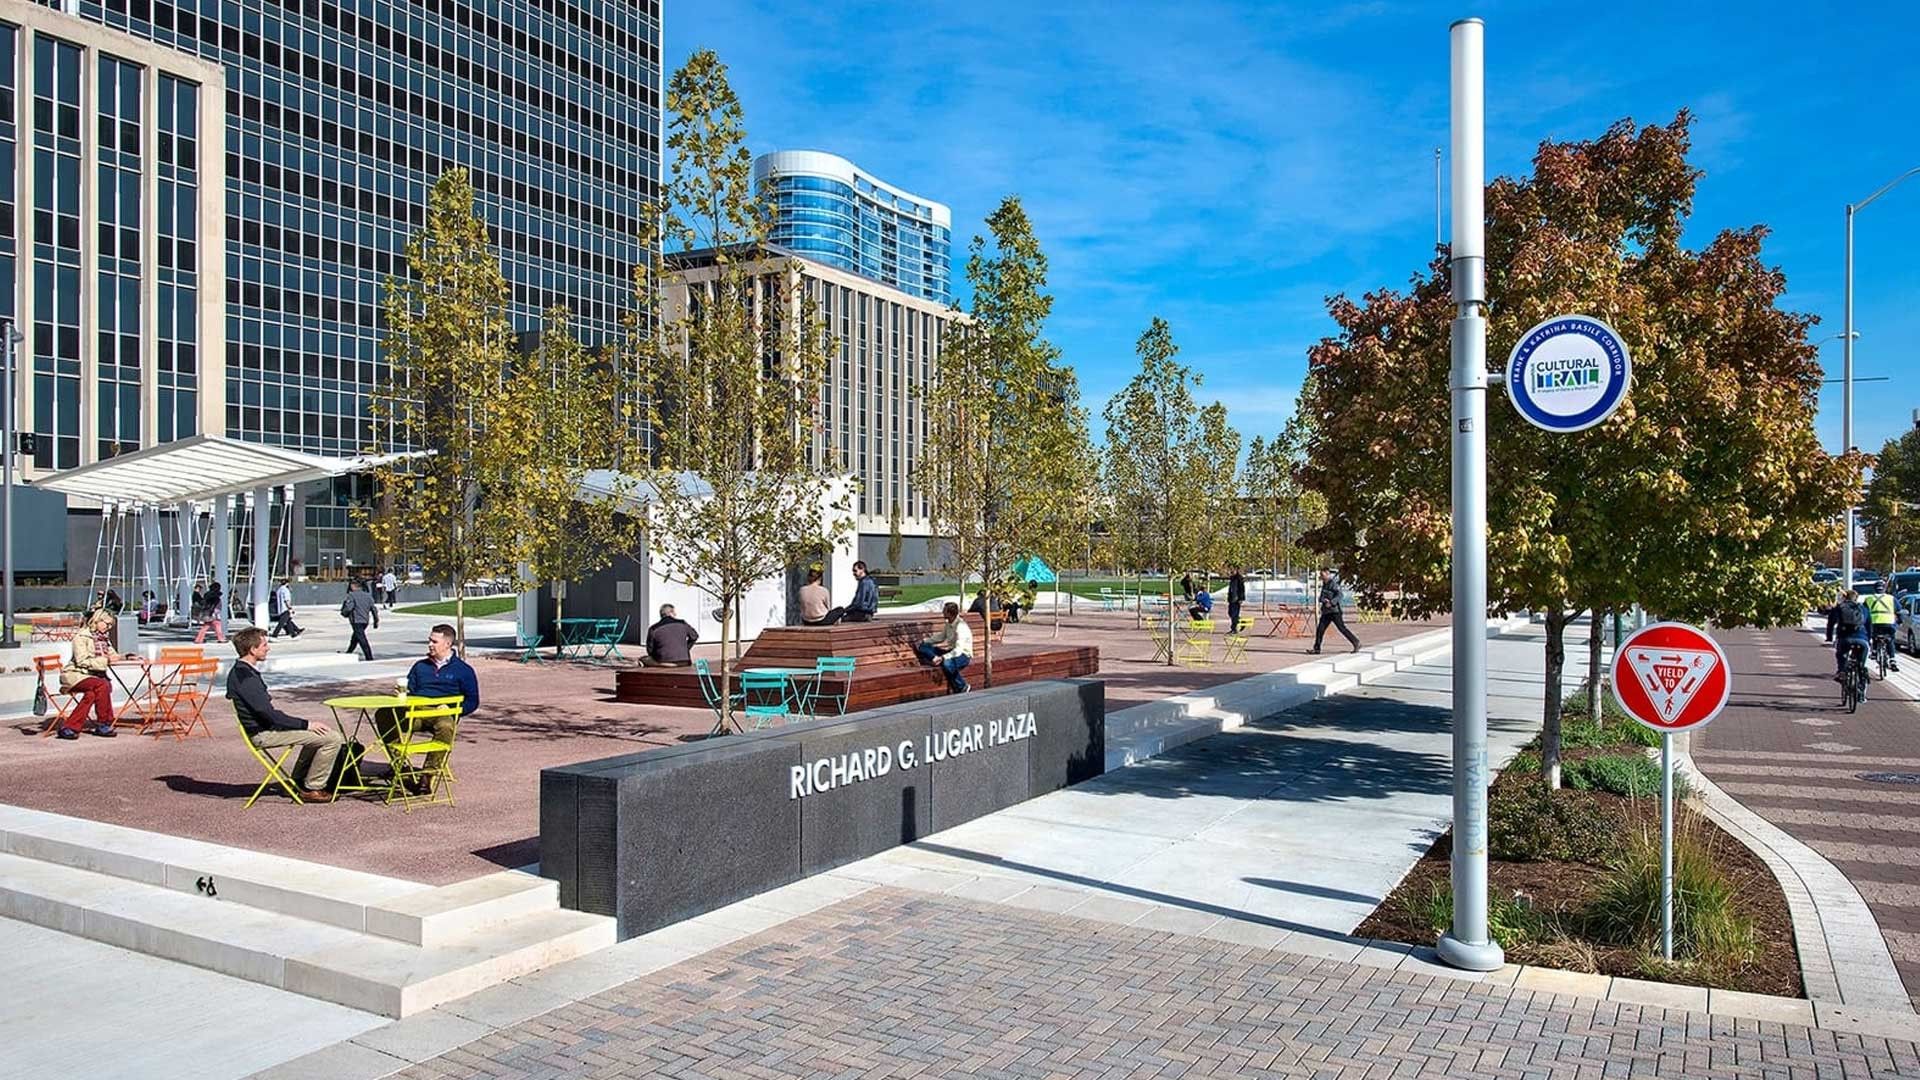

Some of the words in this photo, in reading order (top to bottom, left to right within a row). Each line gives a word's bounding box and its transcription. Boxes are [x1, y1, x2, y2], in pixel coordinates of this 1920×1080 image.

[1513, 356, 1525, 383] FRANK
[1530, 324, 1567, 346] KATRINA
[1571, 324, 1600, 337] BASILE
[1602, 335, 1622, 376] CORRIDOR
[1536, 358, 1599, 372] CULTURAL
[1537, 369, 1599, 388] TRAIL
[1657, 667, 1684, 678] YIELD
[1664, 679, 1675, 688] TO
[790, 745, 892, 799] RICHARD
[898, 740, 919, 769] G.
[924, 724, 984, 764] LUGAR
[989, 712, 1038, 747] PLAZA
[1465, 751, 1481, 850] CULTURAL
